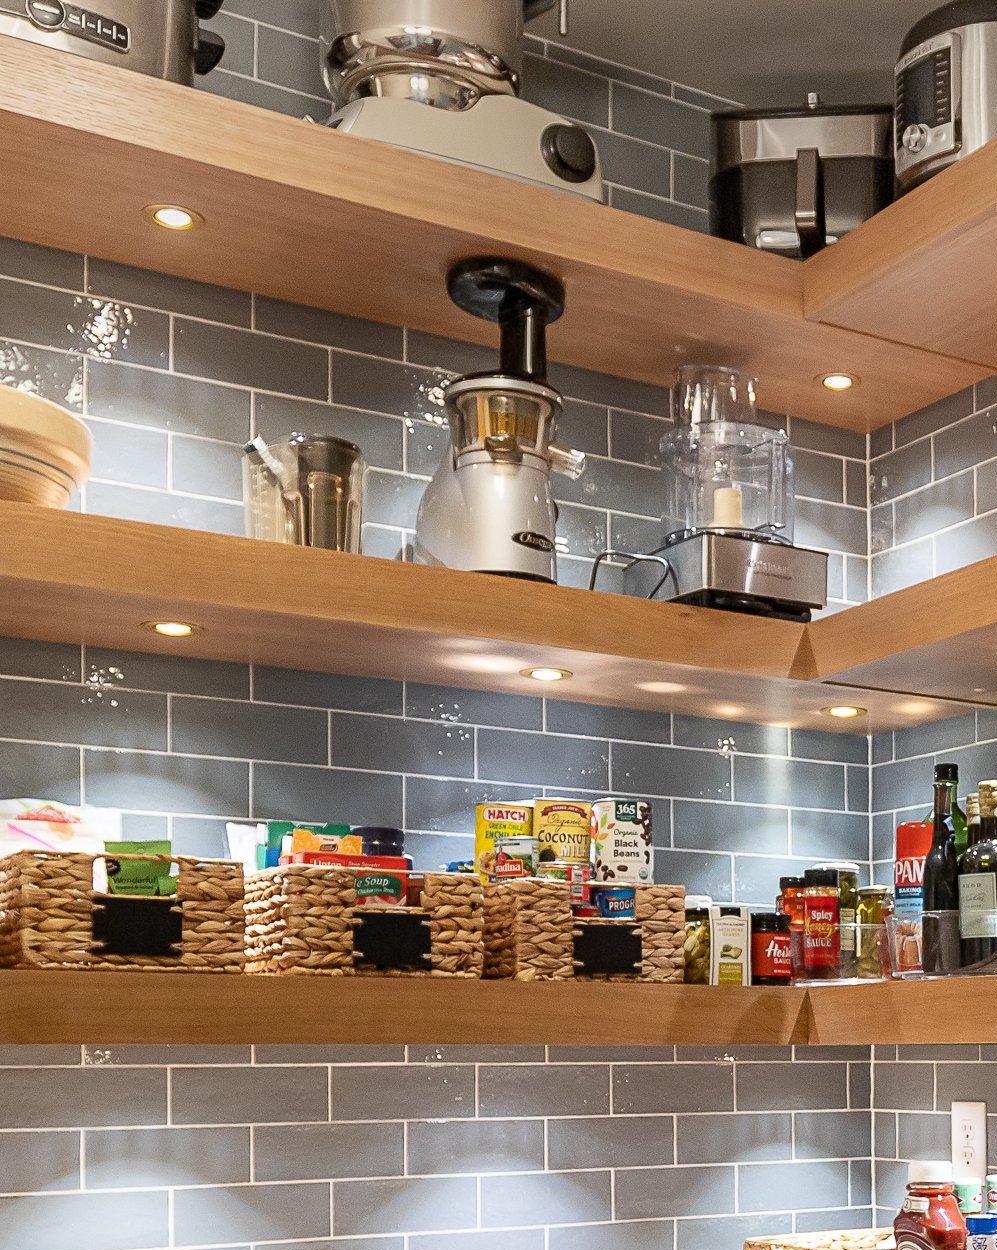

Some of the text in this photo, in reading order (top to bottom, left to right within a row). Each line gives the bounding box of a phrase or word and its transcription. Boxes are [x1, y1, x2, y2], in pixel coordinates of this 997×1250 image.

[617, 804, 635, 814] 365
[488, 809, 526, 820] HATCH
[538, 830, 589, 845] COCONUT
[614, 839, 639, 848] Black
[613, 849, 640, 858] Beans
[364, 876, 389, 887] Soup
[811, 910, 833, 921] Spicy
[806, 938, 832, 947] SAUCE
